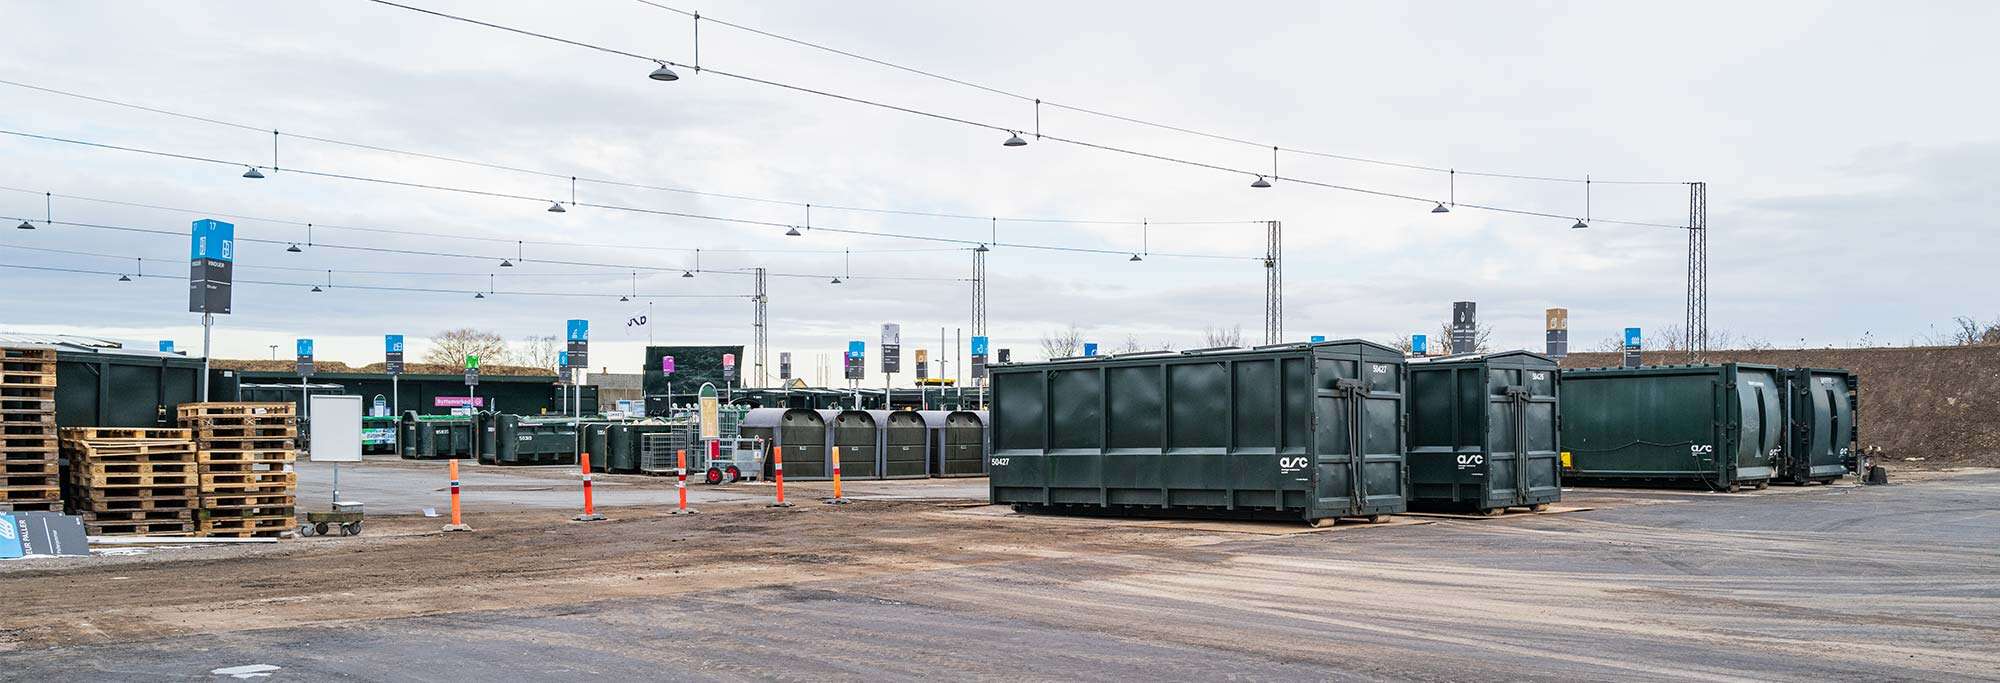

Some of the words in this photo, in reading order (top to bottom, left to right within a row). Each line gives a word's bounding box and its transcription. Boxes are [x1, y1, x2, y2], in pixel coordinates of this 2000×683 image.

[210, 221, 217, 231] 17
[991, 458, 1010, 466] 50427
[19, 519, 31, 542] PALLER
